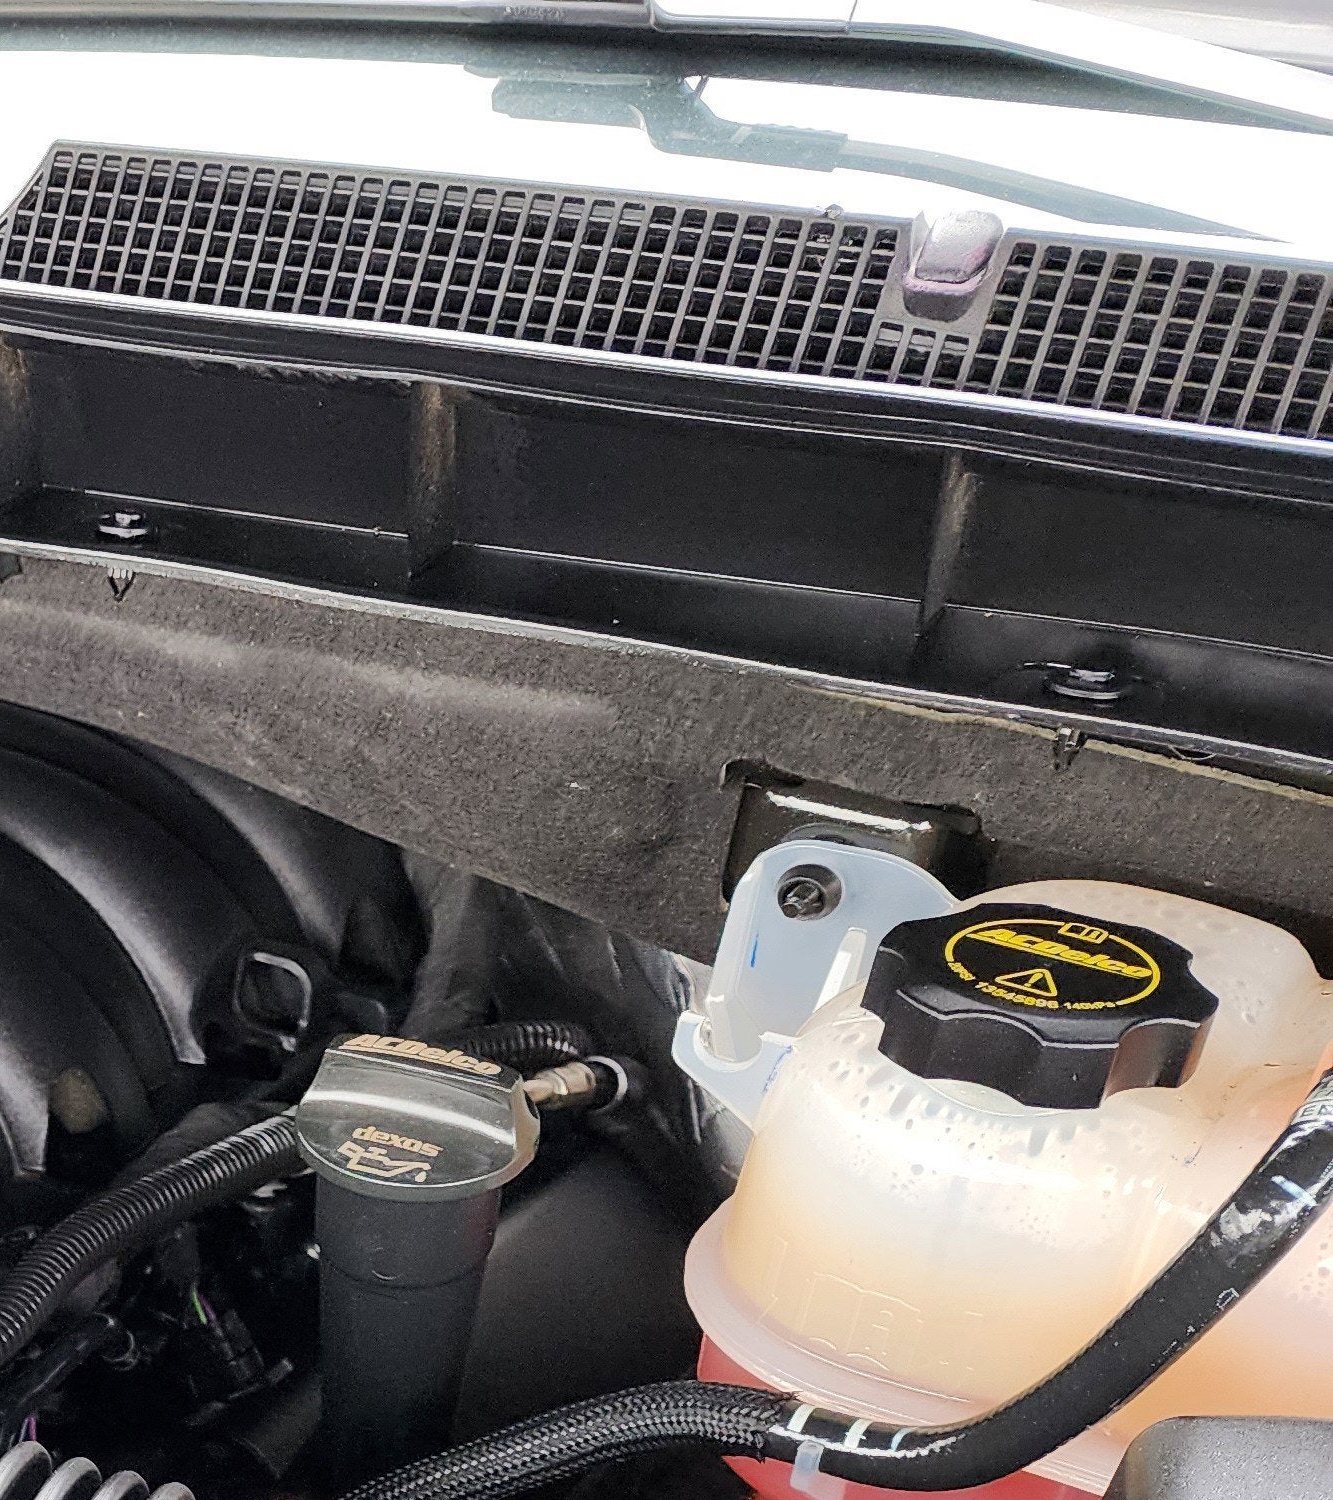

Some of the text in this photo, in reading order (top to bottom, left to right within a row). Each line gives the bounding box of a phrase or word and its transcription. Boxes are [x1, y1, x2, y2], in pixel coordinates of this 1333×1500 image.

[966, 928, 1154, 979] ACDelco
[338, 1033, 502, 1075] ACDelco
[352, 1125, 444, 1158] dexos
